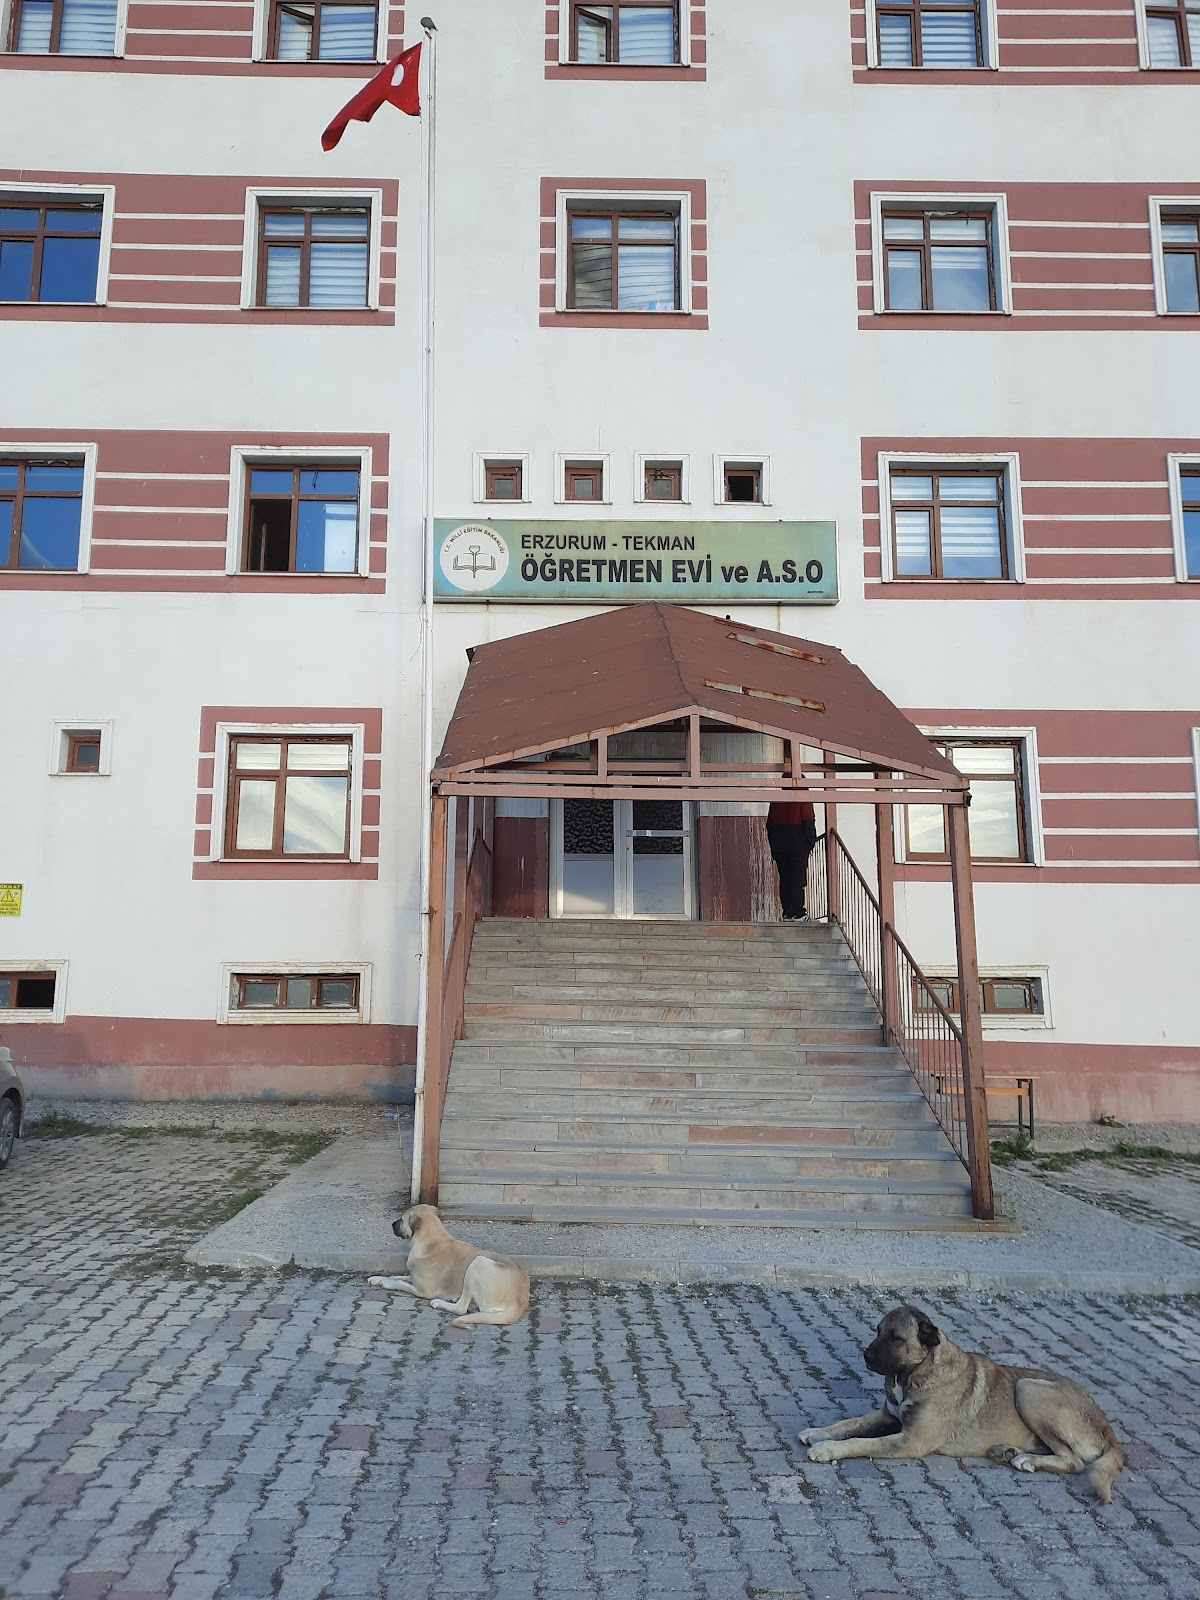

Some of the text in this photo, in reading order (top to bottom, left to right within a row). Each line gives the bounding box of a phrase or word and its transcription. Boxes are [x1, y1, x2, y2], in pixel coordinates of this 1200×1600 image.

[450, 530, 463, 543] MİLLİ
[483, 529, 505, 554] BAKANLIĞI
[521, 534, 606, 550] ERZURUM
[622, 535, 695, 551] TEKMAN
[521, 552, 824, 584] ÖĞRETMEN EVİ ve A.S.O
